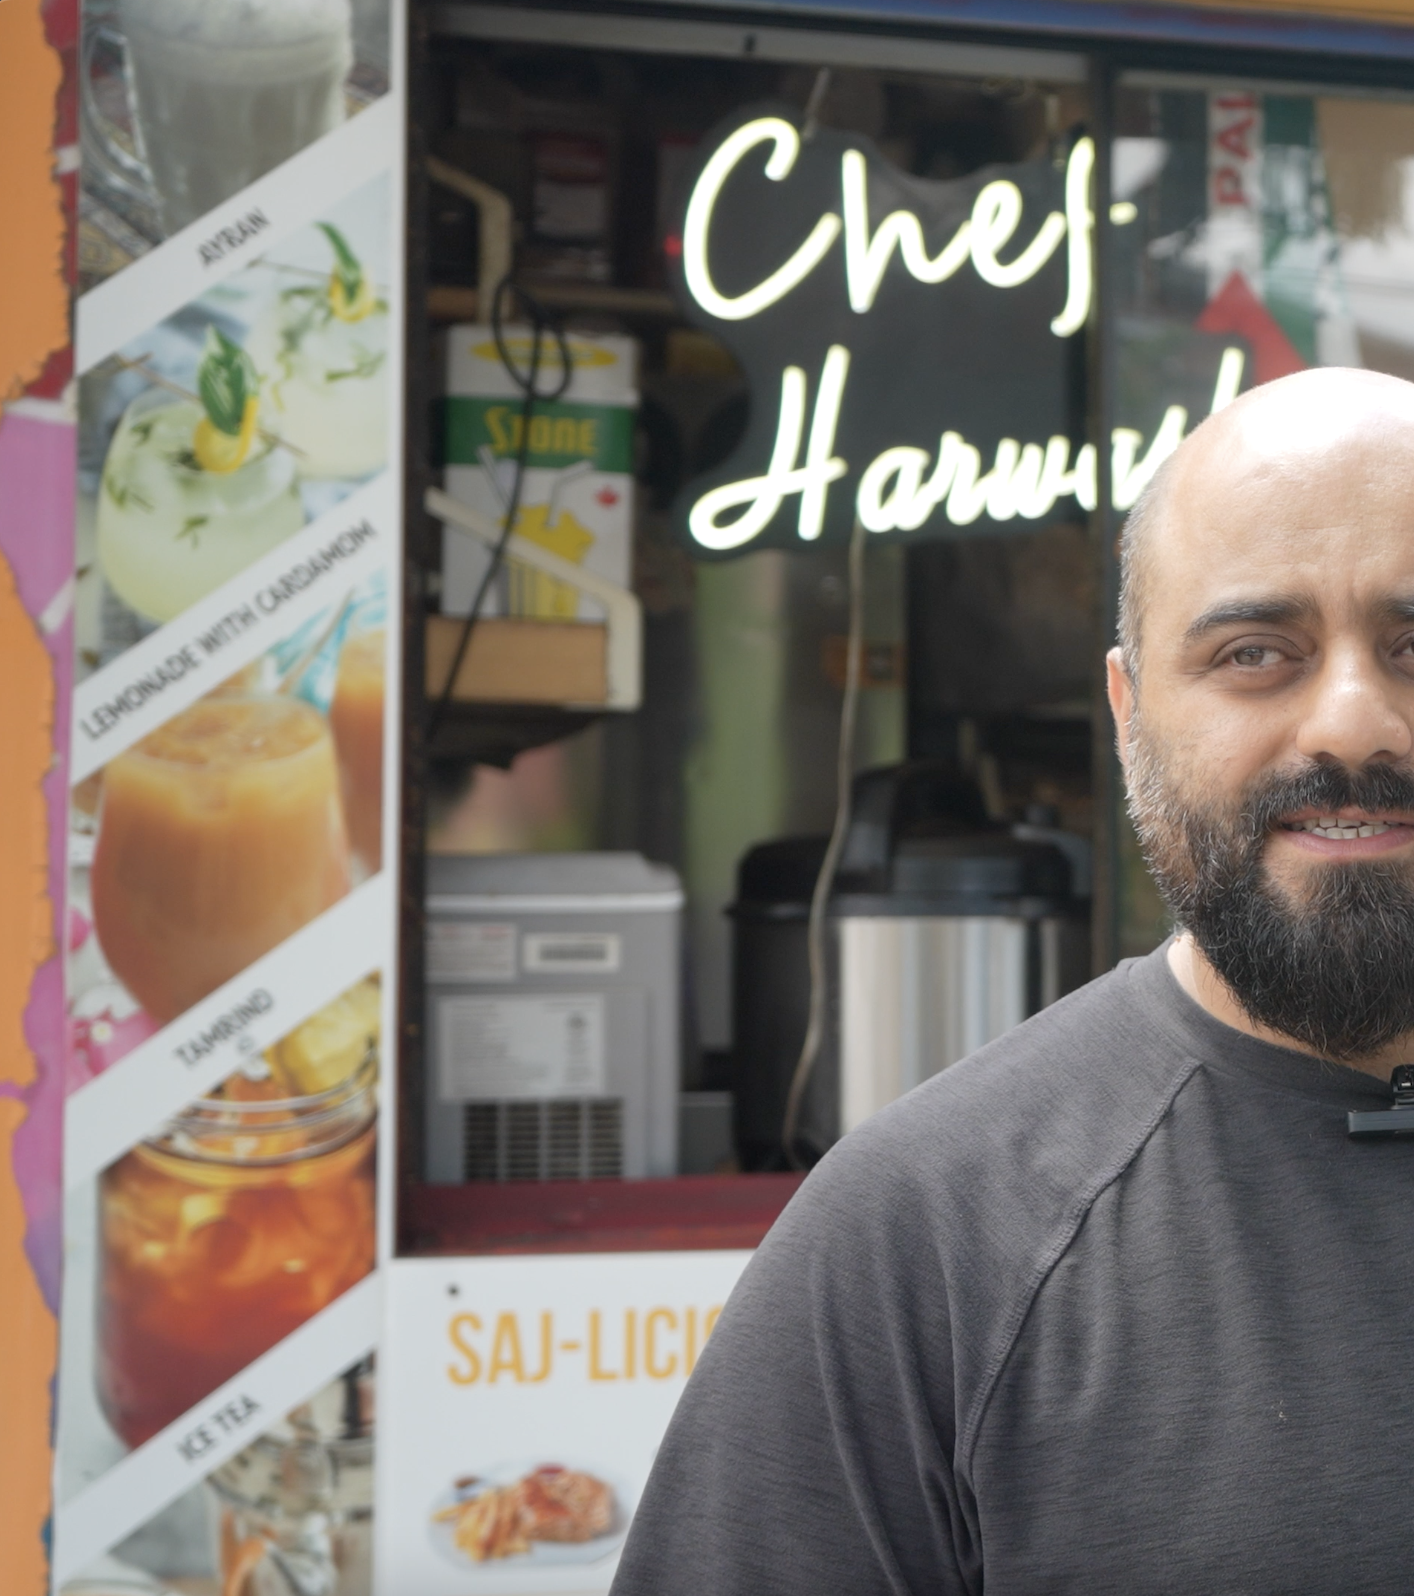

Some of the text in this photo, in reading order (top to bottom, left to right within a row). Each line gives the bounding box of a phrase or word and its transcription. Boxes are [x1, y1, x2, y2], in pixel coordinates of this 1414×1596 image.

[197, 206, 270, 268] AYRAN
[683, 117, 1137, 337] Chef
[484, 405, 598, 456] STONE
[80, 517, 378, 743] LEMONADE WITH CARDAMOM
[176, 1393, 262, 1466] ICE TEA
